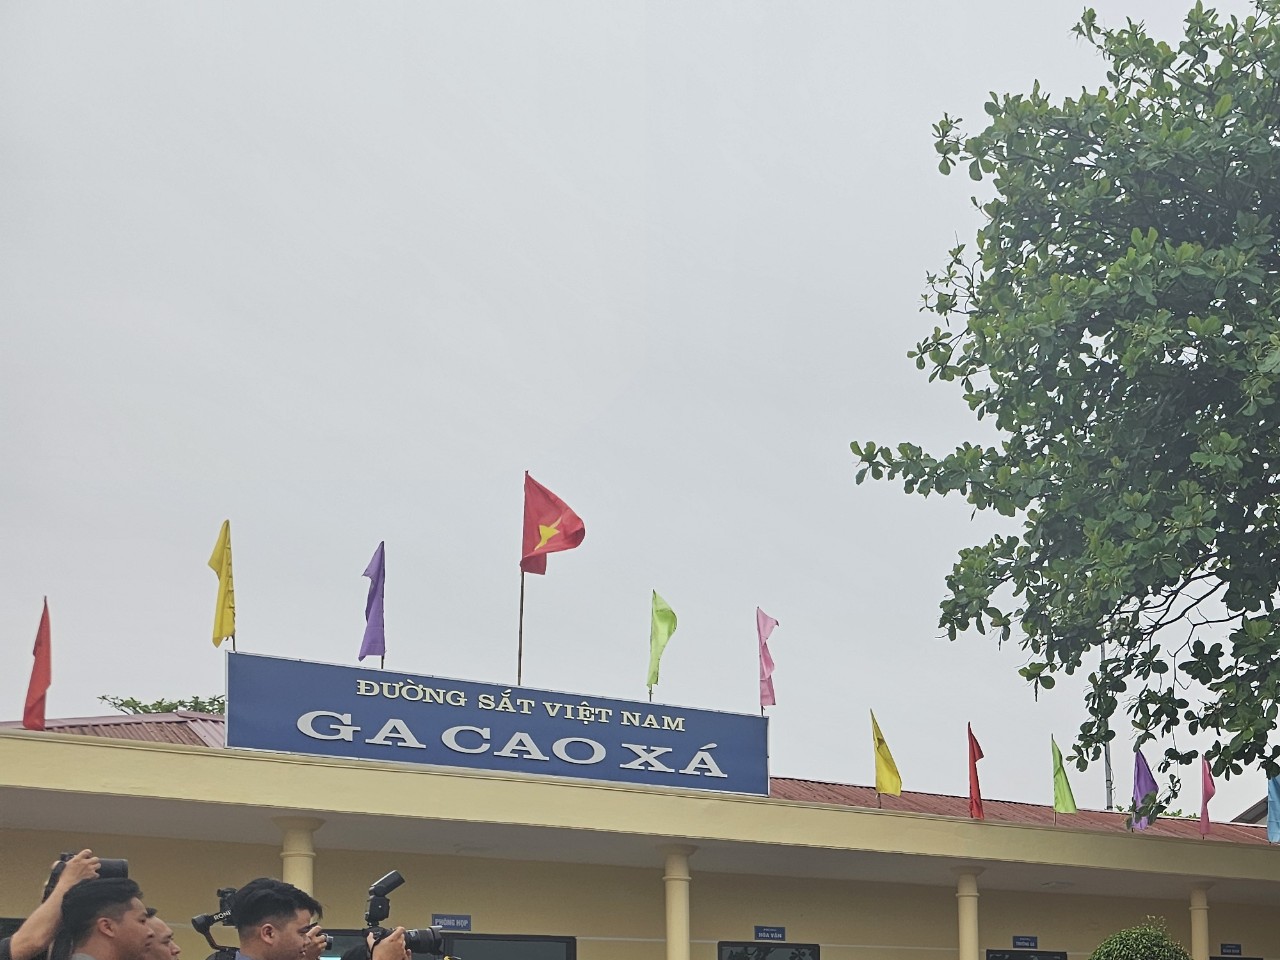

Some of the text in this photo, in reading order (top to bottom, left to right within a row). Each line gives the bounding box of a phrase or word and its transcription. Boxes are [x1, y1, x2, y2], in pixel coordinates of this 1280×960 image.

[356, 679, 686, 732] ĐƯỜNG SẮT VIỆT NAM
[296, 710, 729, 778] GA CAO XÁ
